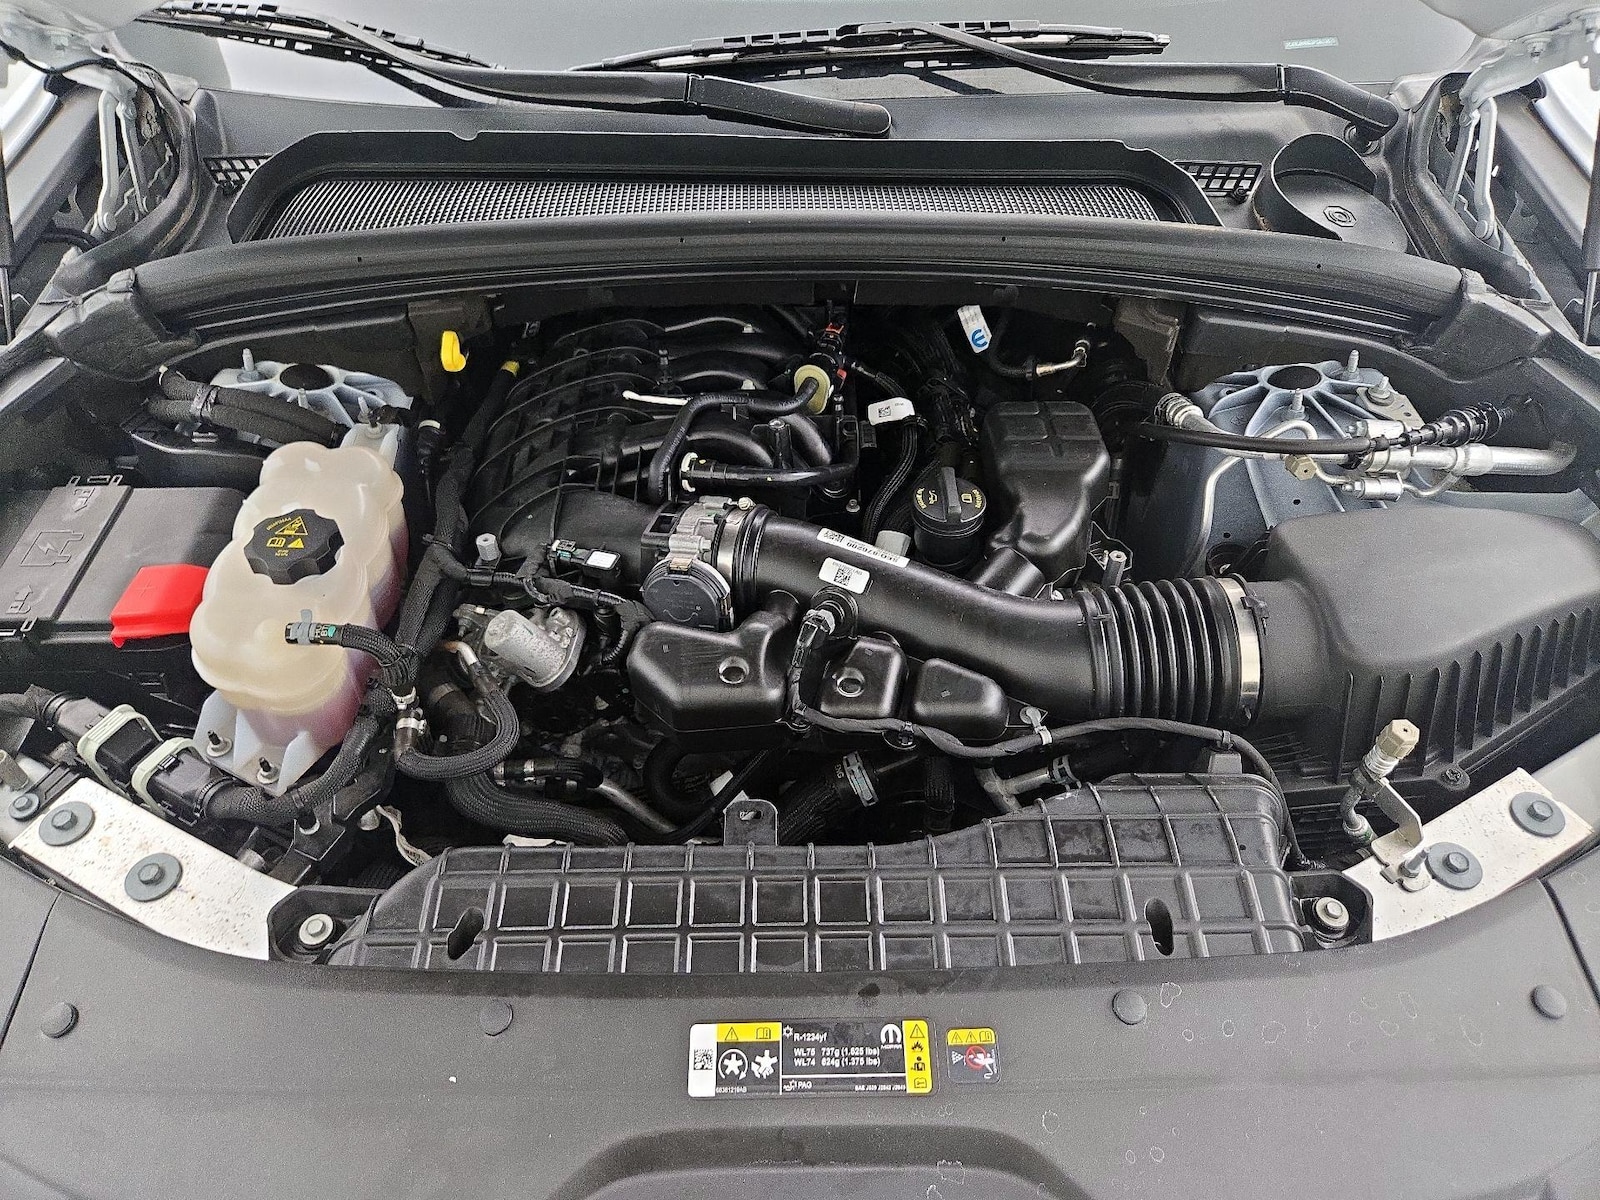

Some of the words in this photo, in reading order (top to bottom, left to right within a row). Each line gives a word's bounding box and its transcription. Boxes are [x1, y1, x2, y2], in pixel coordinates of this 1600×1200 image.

[793, 1032, 828, 1044] R-1234yf
[793, 1047, 816, 1057] WL75
[821, 1047, 840, 1058] 737g
[865, 1046, 880, 1057] lbs)
[793, 1057, 816, 1067] WL74
[866, 1056, 881, 1067] lbs)
[797, 1080, 813, 1090] PAG
